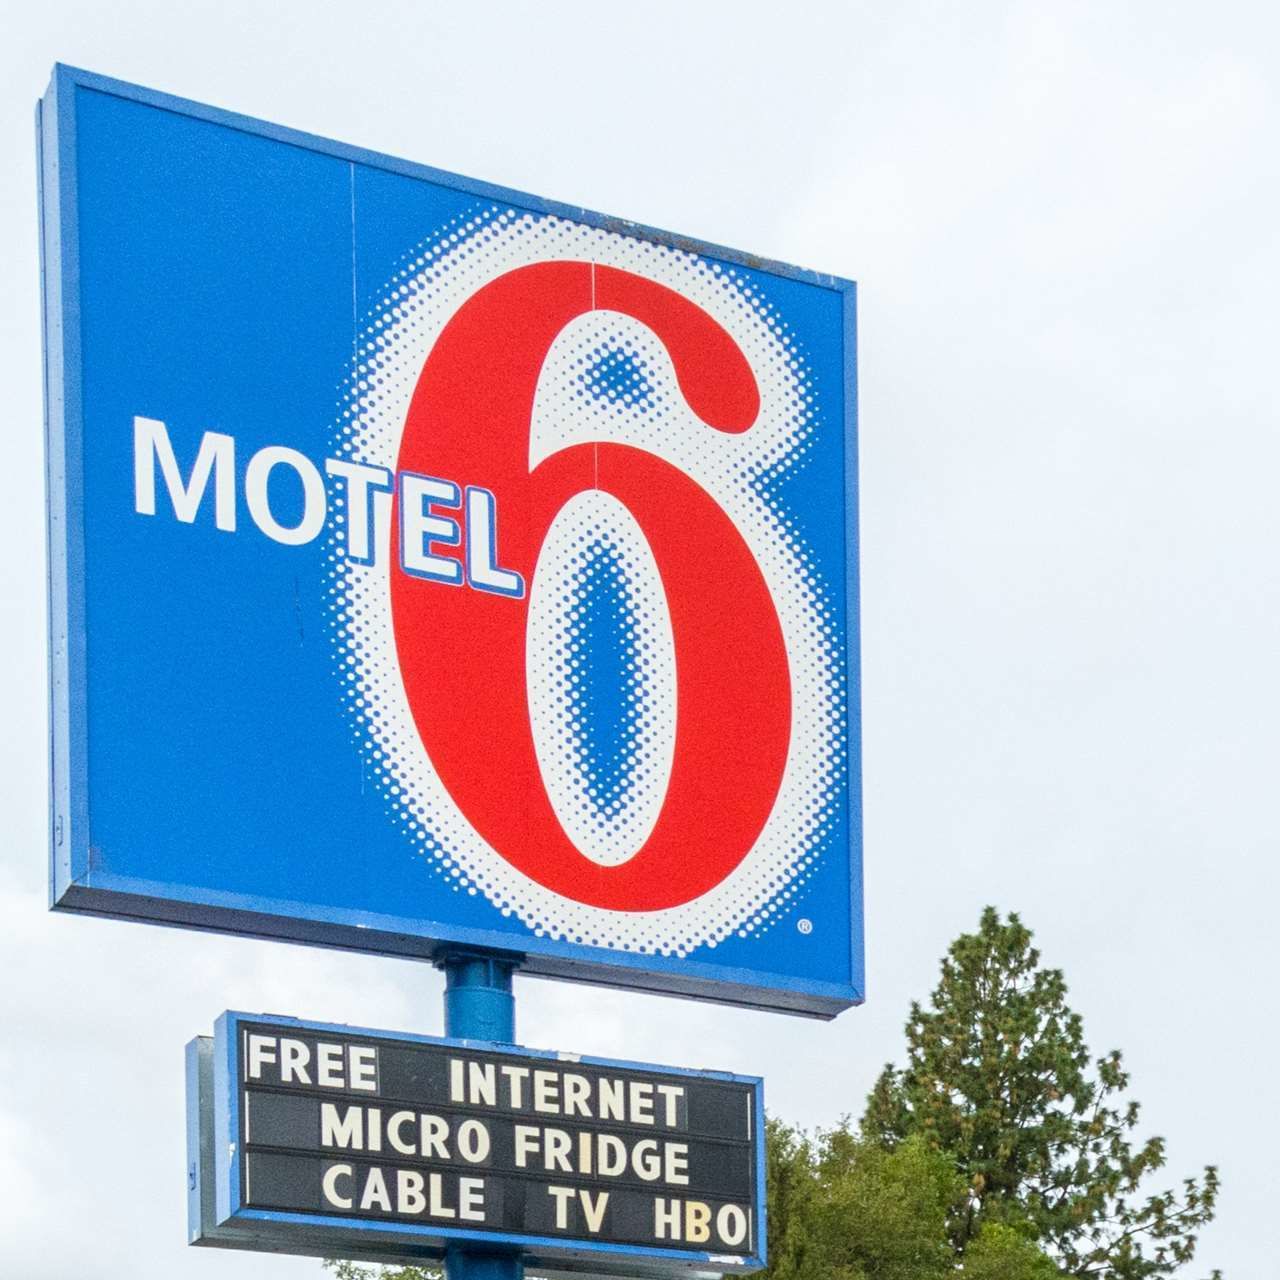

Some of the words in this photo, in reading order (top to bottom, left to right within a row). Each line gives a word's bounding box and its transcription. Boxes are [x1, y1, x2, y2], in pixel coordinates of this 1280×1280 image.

[134, 416, 523, 595] MOTEL
[391, 261, 792, 912] 6
[245, 1034, 377, 1091] FREE
[450, 1059, 684, 1127] INTERNET
[321, 1103, 490, 1163] MICRO
[514, 1125, 689, 1185] FRIDGE
[322, 1164, 485, 1221] CABLE
[548, 1185, 609, 1233] TV
[655, 1197, 747, 1246] HBO
